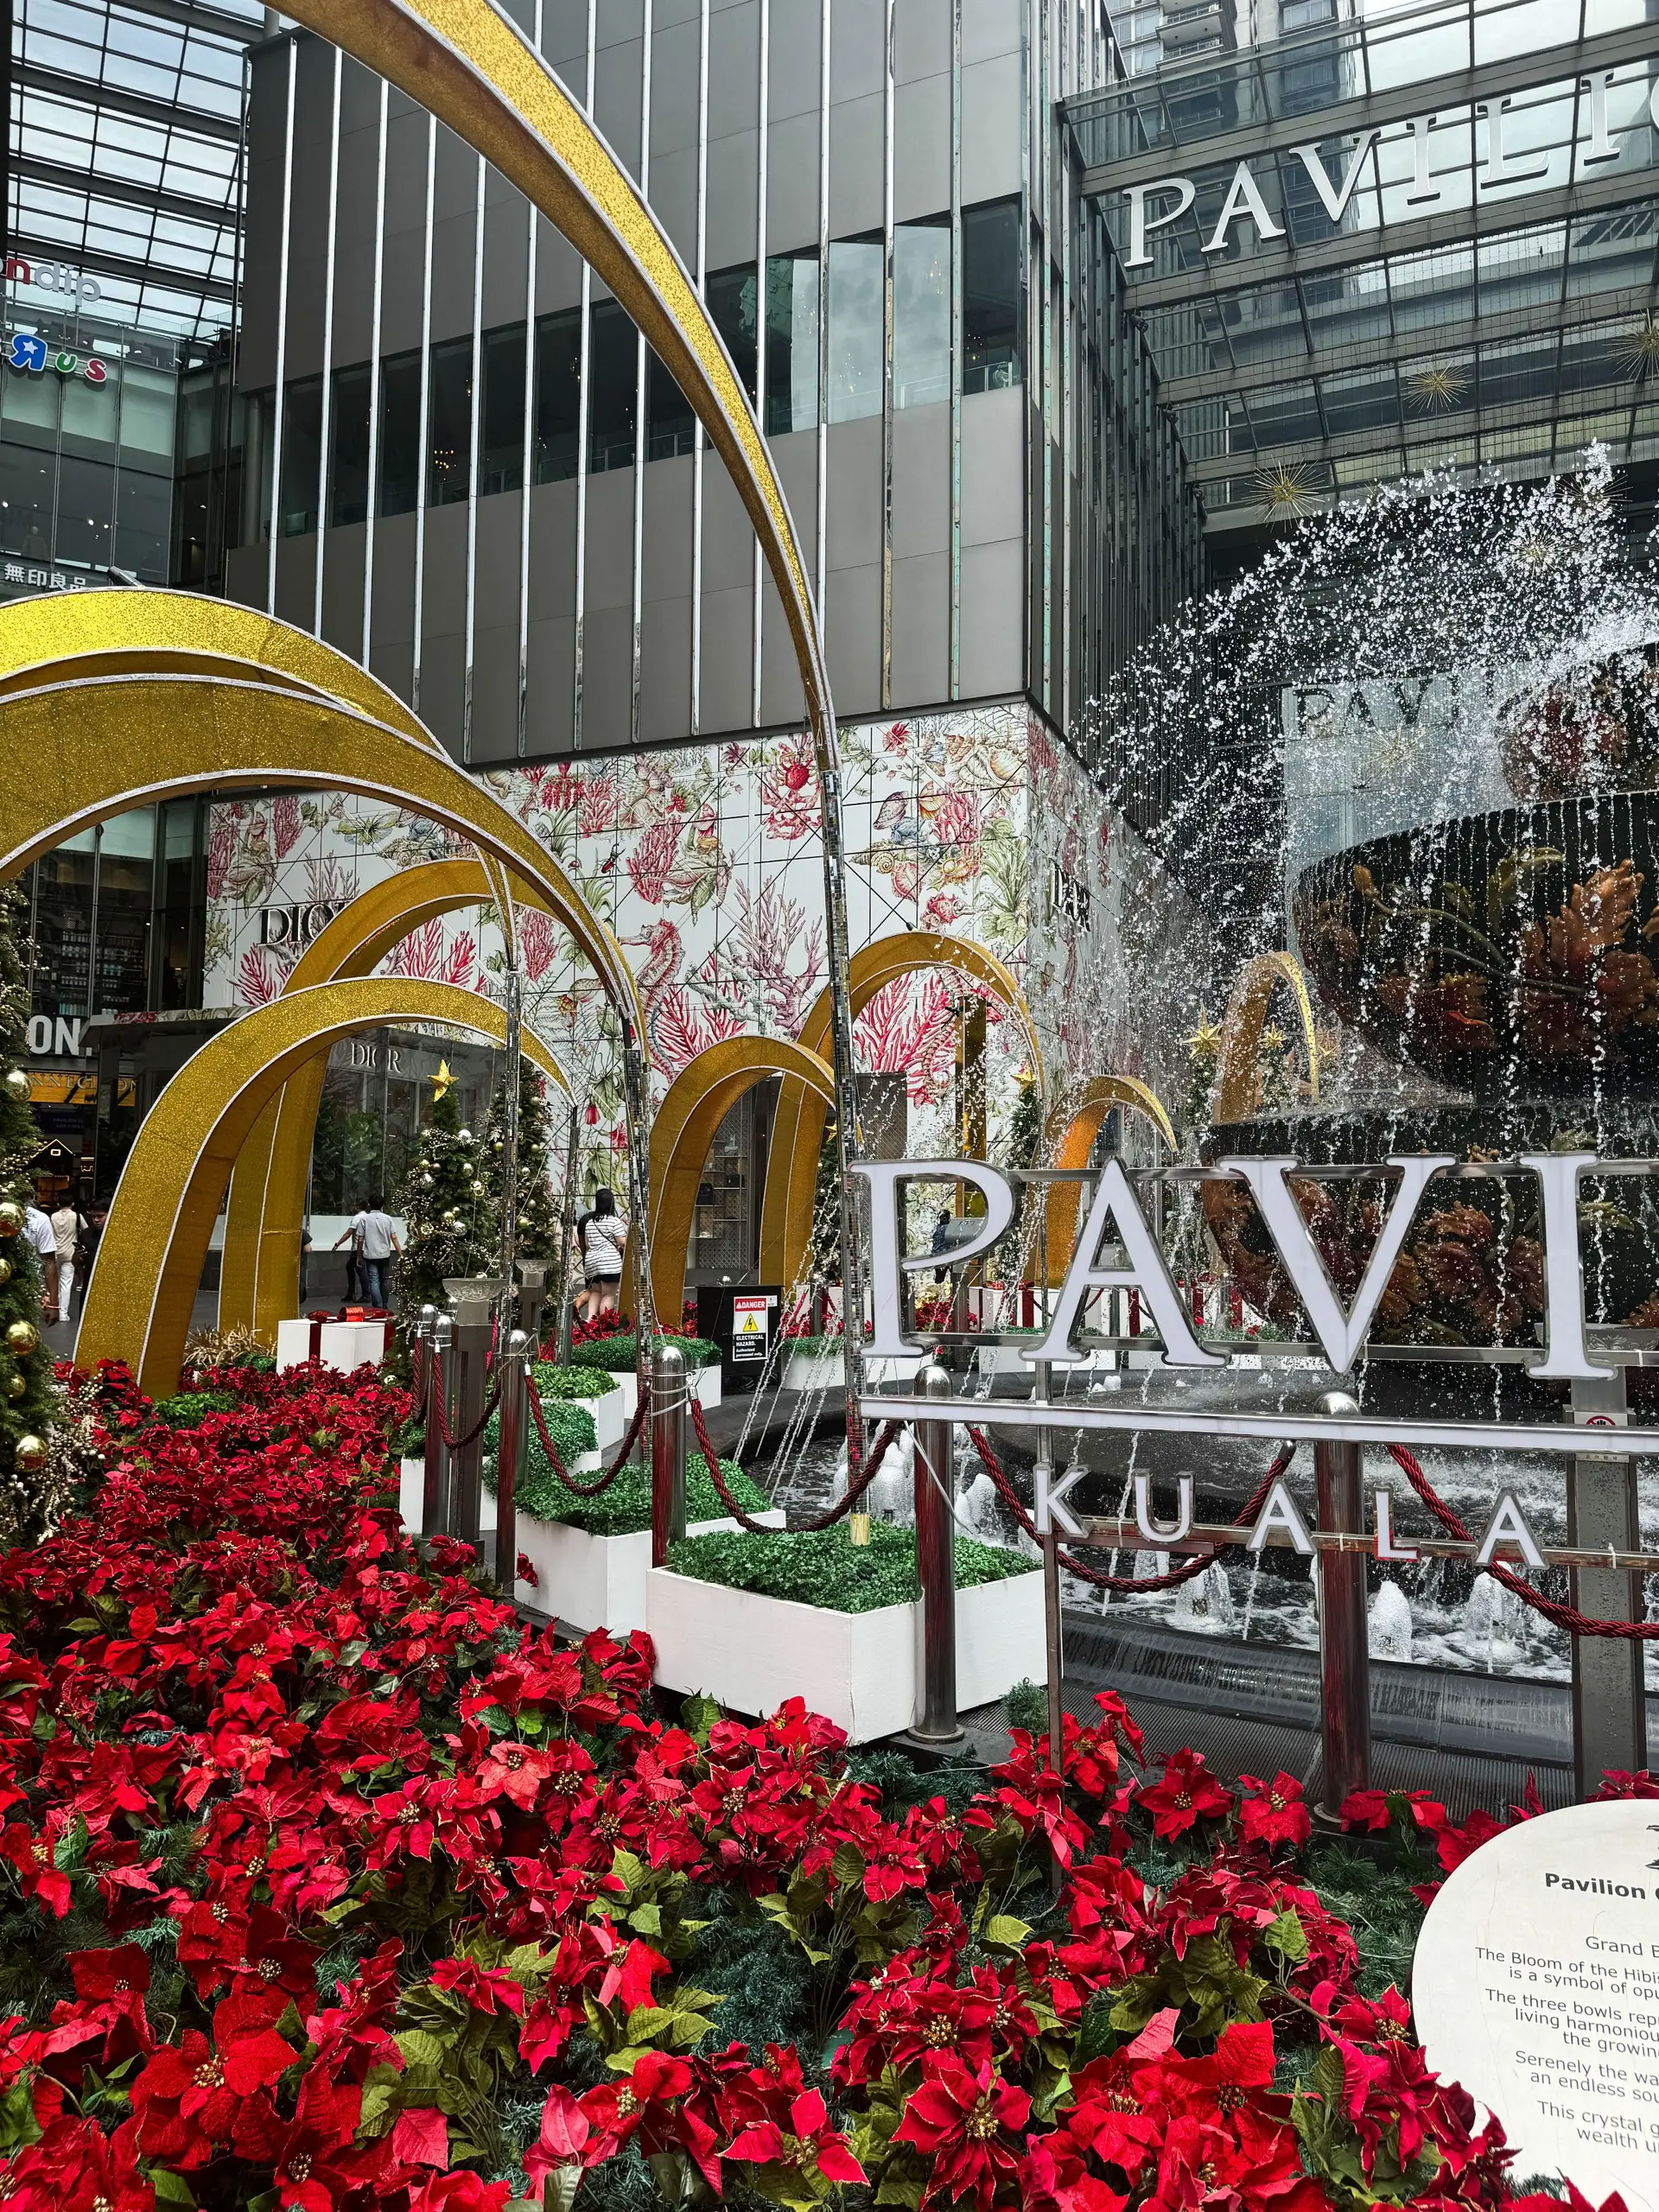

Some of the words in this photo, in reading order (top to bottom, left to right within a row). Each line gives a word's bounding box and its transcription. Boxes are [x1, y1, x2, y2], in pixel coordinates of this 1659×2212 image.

[1122, 70, 1659, 270] PAVILI
[0, 258, 102, 308] ndip
[3, 563, 86, 591] 無印良品
[257, 901, 347, 946] DIO
[350, 1042, 402, 1074] DIR
[741, 1300, 766, 1309] DANGER
[1033, 1463, 1550, 1569] KUALA
[1545, 1872, 1646, 1899] Pavilion
[1586, 1936, 1643, 1956] Grand
[1475, 1947, 1505, 1962] The
[1511, 1952, 1562, 1971] Bloom
[1568, 1961, 1585, 1974] of
[1590, 1963, 1618, 1978] the
[1624, 1967, 1659, 1985] Hibi
[1510, 1966, 1522, 1980] is
[1529, 1971, 1538, 1981] a
[1544, 1974, 1604, 1991] symbol
[1611, 1981, 1627, 1994] of
[1485, 1988, 1516, 2005] The
[1522, 1994, 1567, 2012] three
[1573, 2000, 1623, 2020] bowls
[1629, 2012, 1659, 2029] rep
[1515, 2007, 1560, 2030] living
[1563, 2031, 1592, 2048] the
[1598, 2039, 1659, 2059] growin
[1515, 2050, 1592, 2077] Serenely
[1599, 2063, 1628, 2082] the
[1634, 2072, 1659, 2087] wa
[1530, 2071, 1552, 2086] an
[1559, 2077, 1625, 2098] endless
[1537, 2100, 1575, 2120] This
[1581, 2111, 1643, 2133] crystal
[1576, 2127, 1639, 2150] wealth
[1645, 2139, 1659, 2153] u
